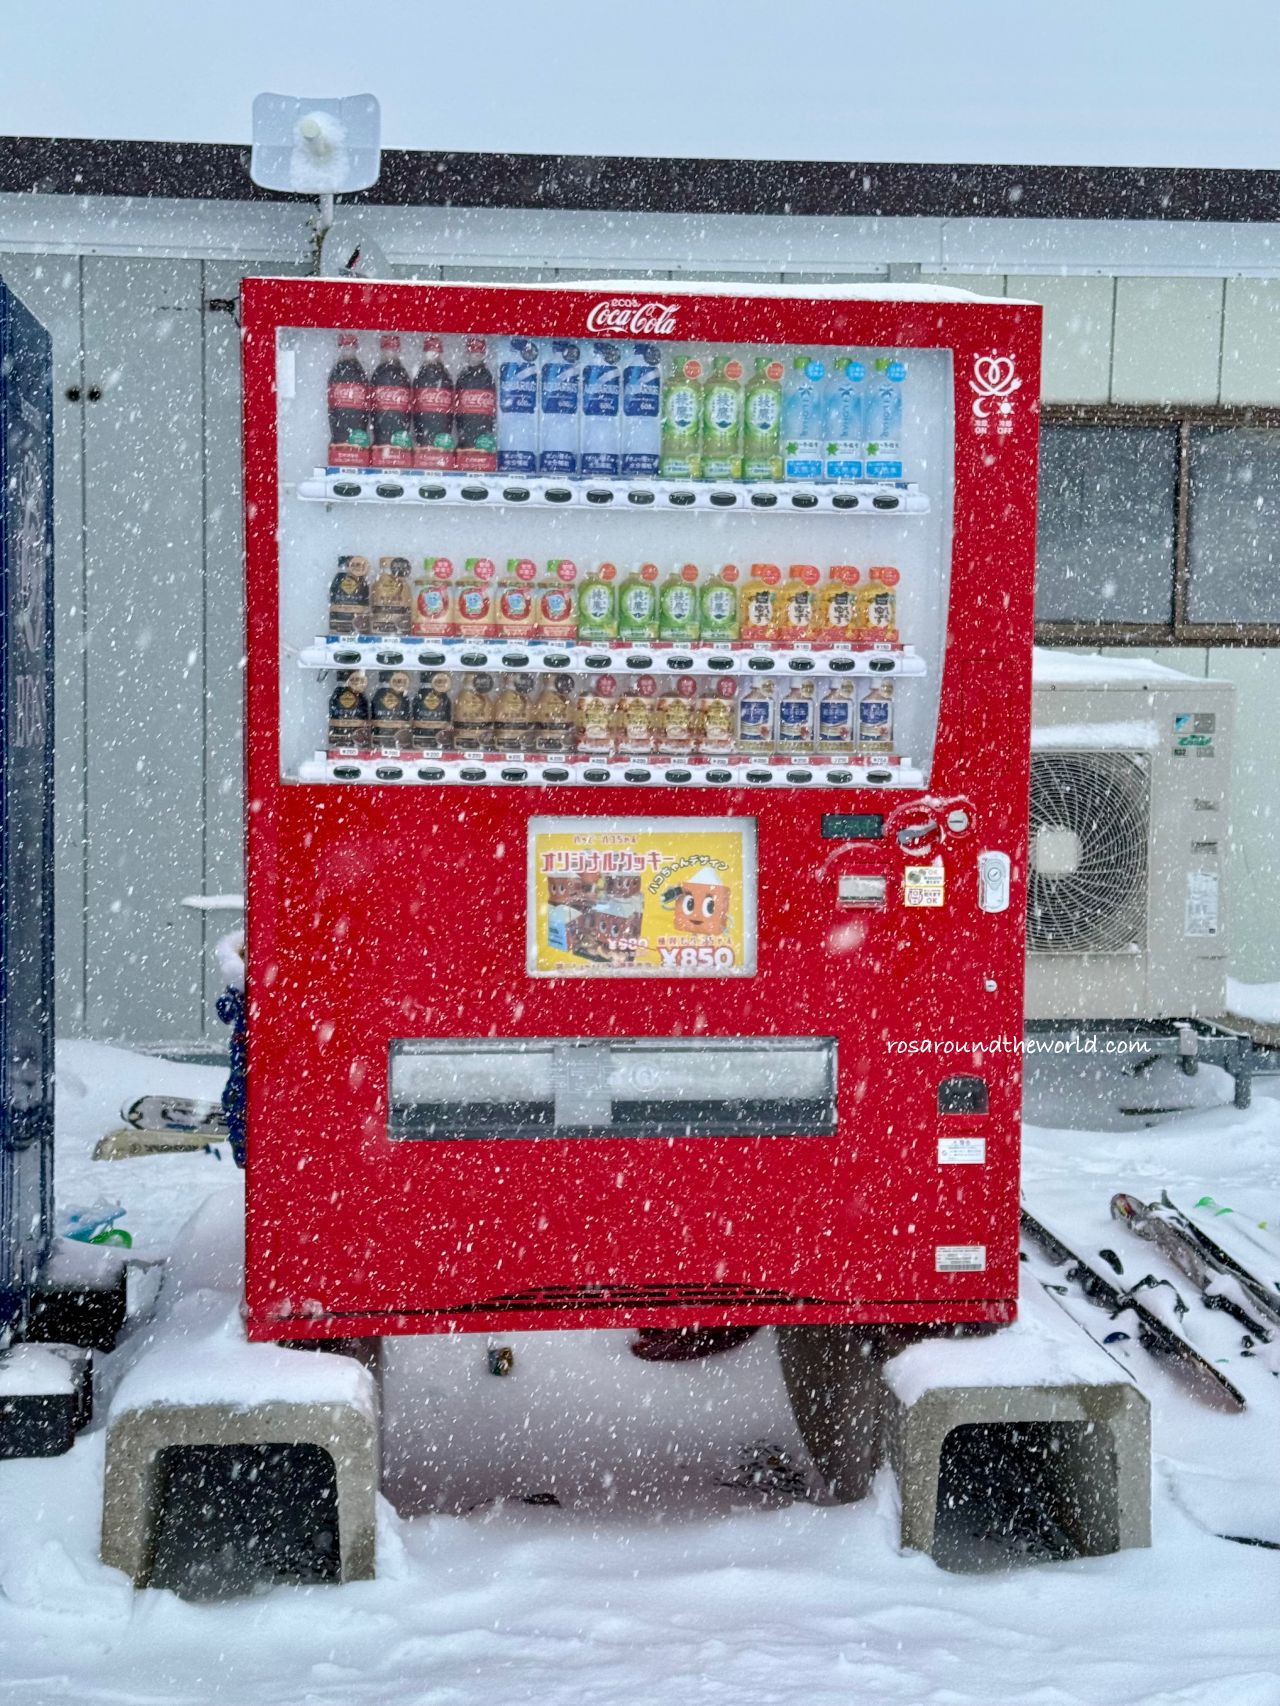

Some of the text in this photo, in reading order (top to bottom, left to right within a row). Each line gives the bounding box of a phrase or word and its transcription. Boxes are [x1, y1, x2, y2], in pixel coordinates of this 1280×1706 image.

[586, 301, 681, 335] Coca-Cola
[541, 851, 675, 872] オリジナルクッキー
[648, 854, 730, 895] ハコちゃんデザイン
[660, 946, 735, 967] ¥850
